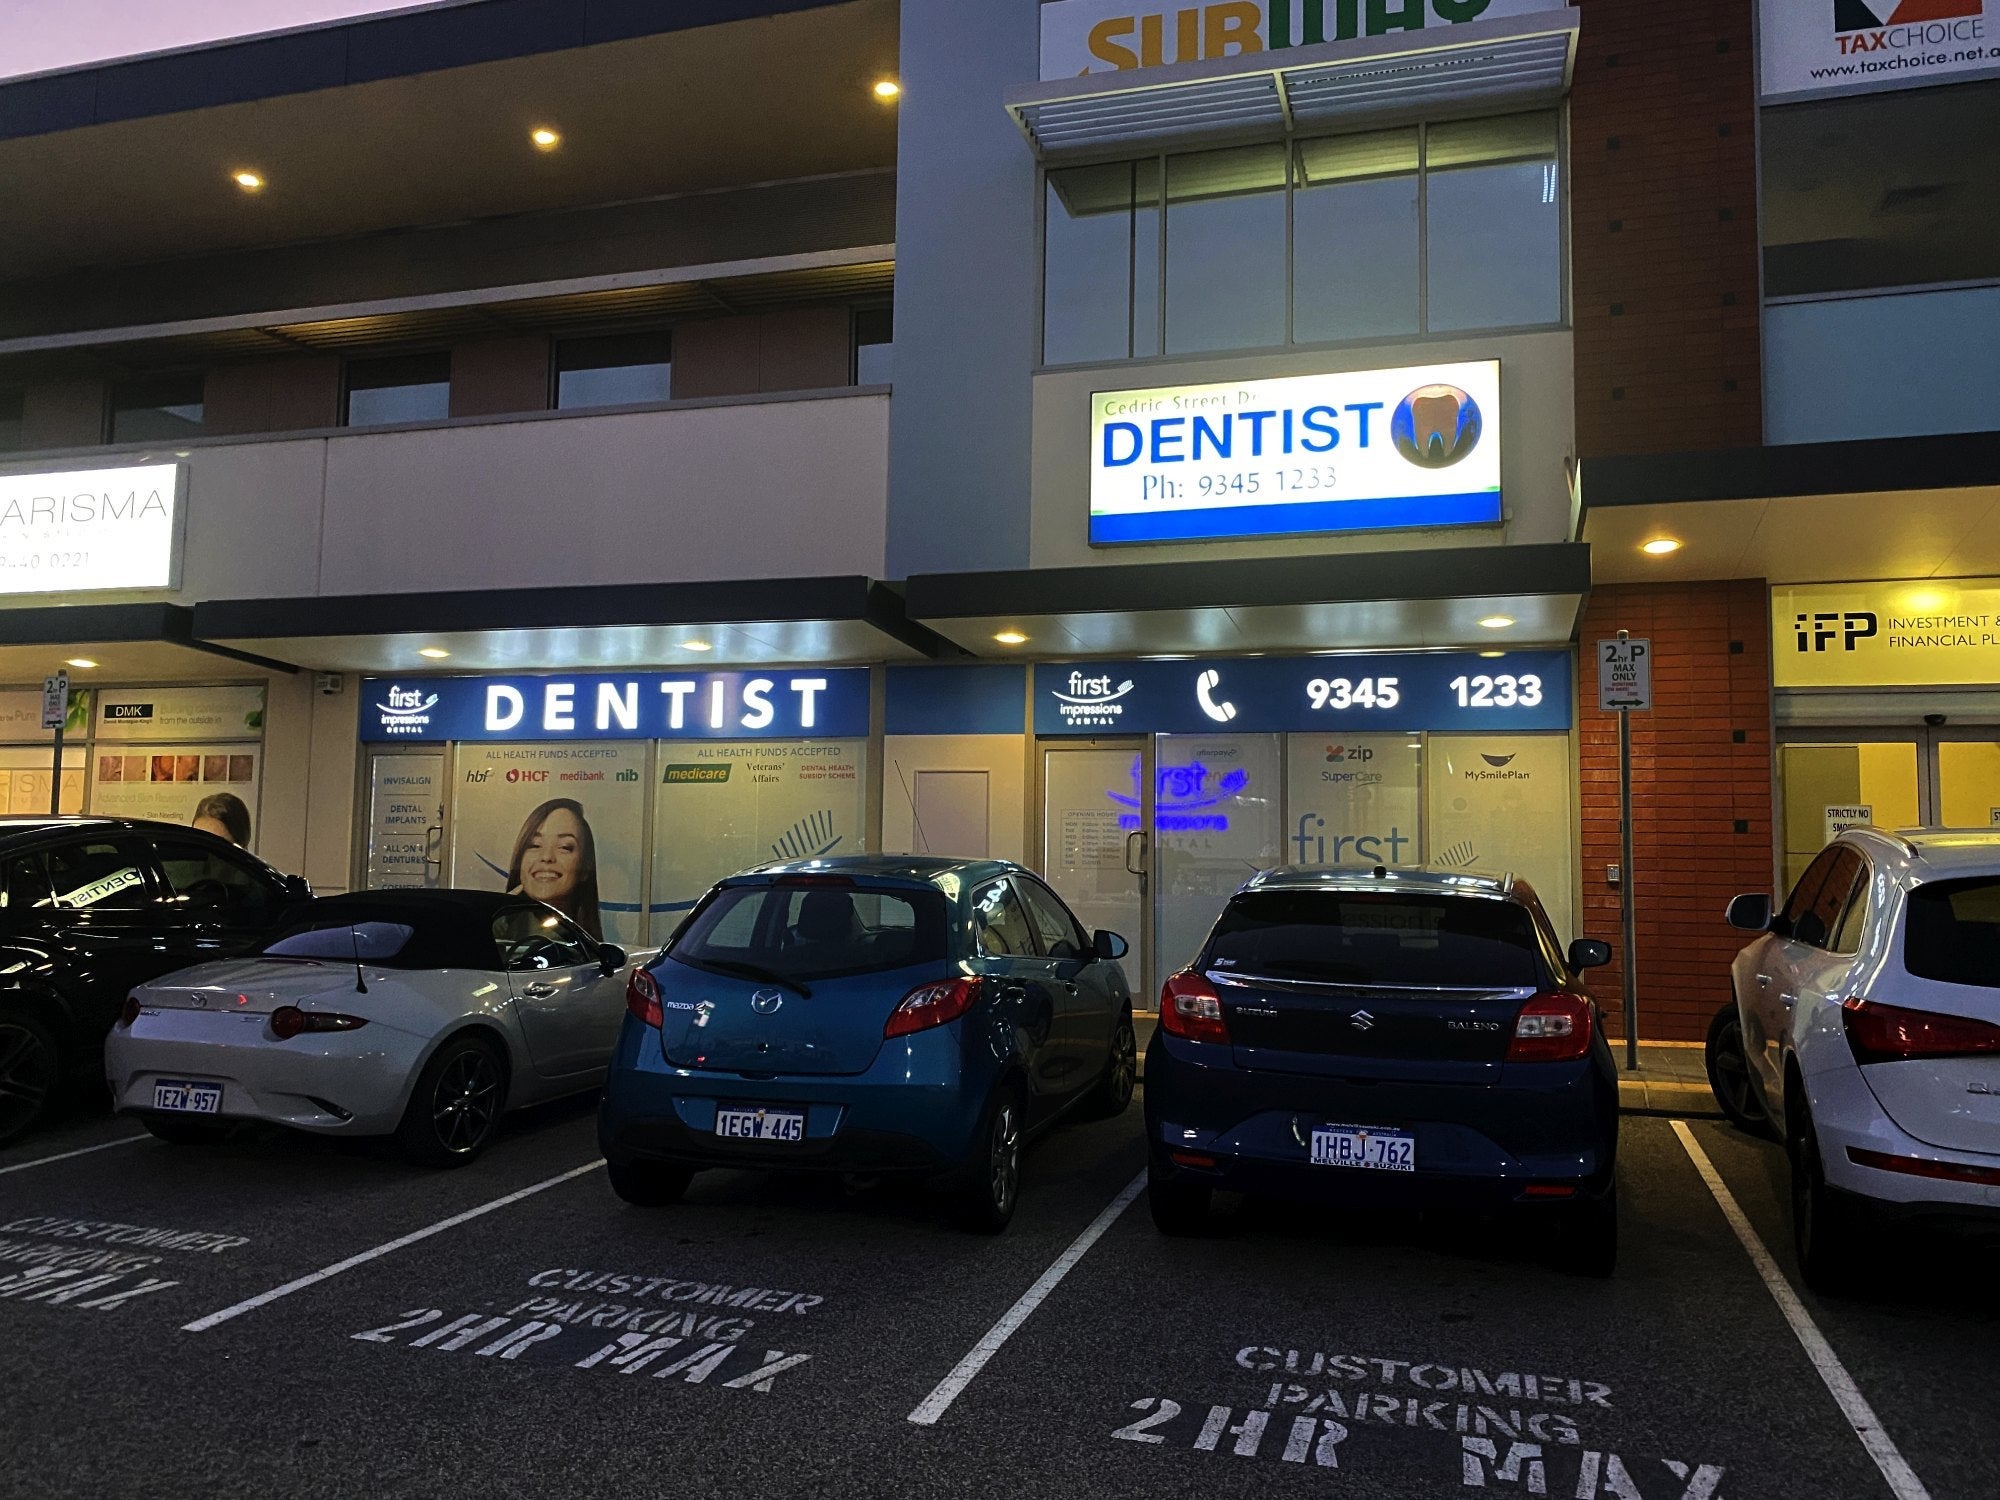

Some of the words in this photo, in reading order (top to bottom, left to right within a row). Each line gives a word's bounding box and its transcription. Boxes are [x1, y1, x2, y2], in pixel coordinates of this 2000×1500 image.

[1835, 18, 1985, 55] TAXCHOICE
[1103, 402, 1384, 468] DENTIST
[1142, 474, 1184, 500] Ph:
[1198, 473, 1260, 497] 9345
[1276, 466, 1338, 492] 1233
[1888, 615, 1990, 629] INVESTMENT
[1889, 634, 1977, 648] FINANCIAL
[1630, 645, 1645, 662] P
[1613, 663, 1635, 672] MAX
[1611, 672, 1637, 681] ONLY
[1068, 671, 1111, 696] first
[388, 685, 422, 707] first
[1306, 677, 1400, 709] 9345
[1449, 674, 1543, 708] 1233
[484, 678, 827, 731] DENTIST
[1060, 703, 1122, 717] impressions
[115, 705, 143, 717] DMK
[381, 713, 430, 725] impressions
[486, 751, 502, 759] ALL
[503, 751, 537, 759] HEALTH
[539, 750, 569, 758] FUNDS
[571, 749, 618, 758] ACCEPTED
[697, 749, 714, 758] ALL
[717, 748, 752, 757] HEALTH
[755, 748, 788, 757] FUNDS
[790, 747, 841, 756] ACCEPTED
[1347, 745, 1373, 762] zip
[746, 762, 786, 772] Veterans'
[522, 771, 550, 782] HCF
[560, 770, 605, 781] medibank
[616, 768, 639, 782] nib
[668, 768, 728, 780] medicare
[751, 774, 780, 783] Affairs
[1321, 771, 1383, 783] SuperCare
[1464, 770, 1530, 781] MySmilePlan
[383, 776, 431, 785] INVISALIGN
[390, 805, 423, 813] DENTAL
[1827, 808, 1857, 818] STRICTLY
[1858, 808, 1869, 818] NO
[385, 816, 427, 825] IMPLANTS
[1292, 812, 1409, 864] first
[386, 845, 401, 853] ALL
[402, 845, 417, 853] ON
[417, 845, 424, 853] 4
[382, 855, 426, 864] DENTURES
[667, 1001, 694, 1010] mazda
[1447, 1021, 1500, 1031] BALENO
[1313, 1158, 1361, 1167] MELVILLE
[1373, 1161, 1411, 1171] SUZUKI
[527, 1268, 824, 1315] CUSTOMER
[506, 1296, 755, 1342] PARKING
[574, 1331, 814, 1393] MAX
[1235, 1345, 1615, 1407] CUSTOMER
[1263, 1381, 1580, 1445] PARKING
